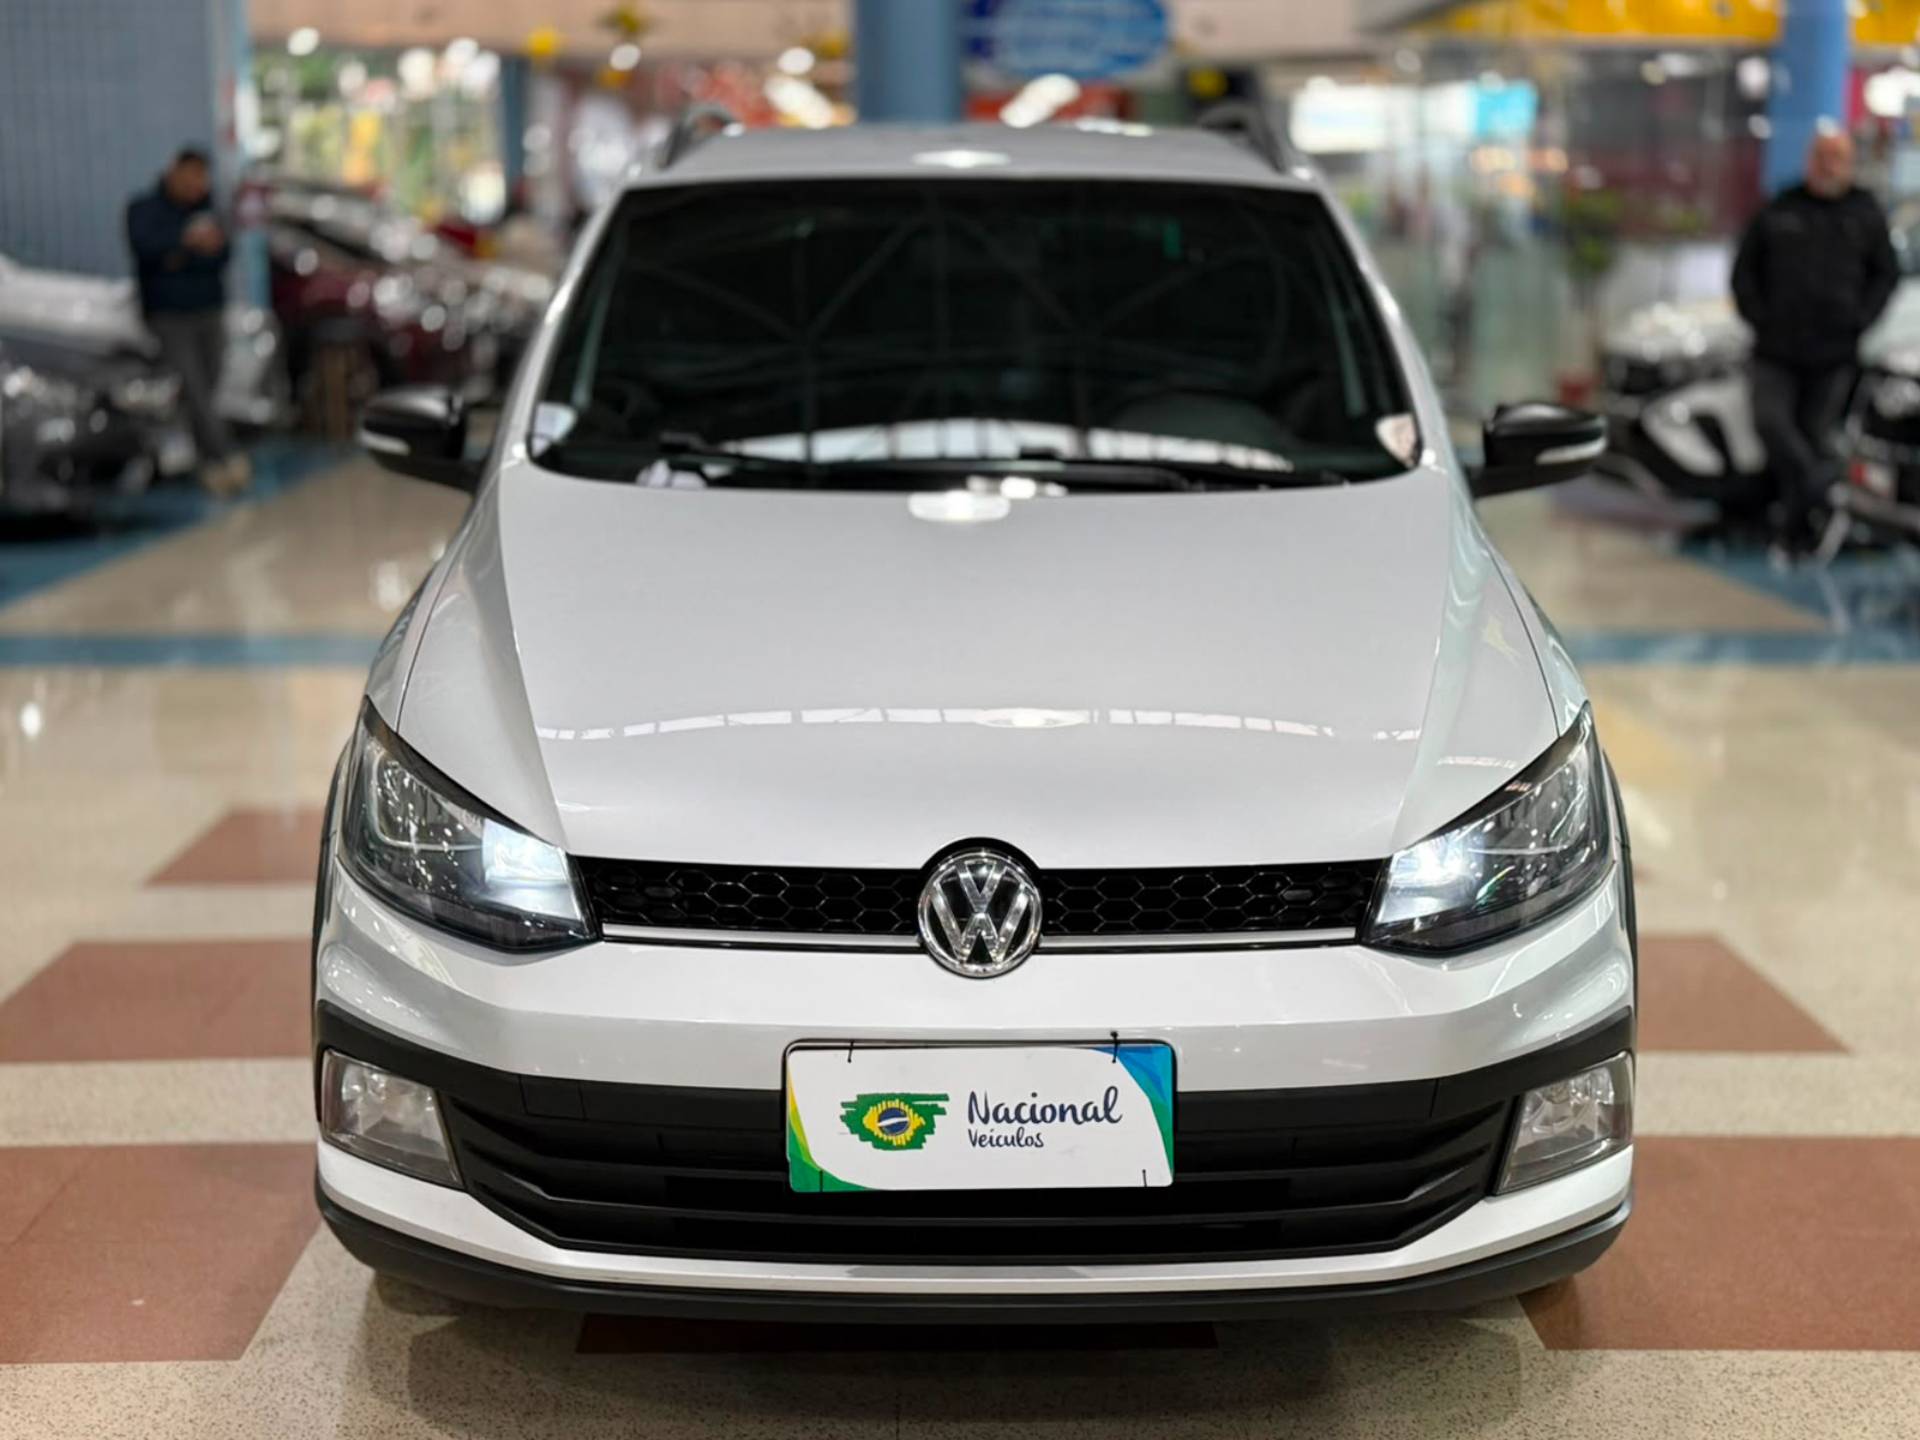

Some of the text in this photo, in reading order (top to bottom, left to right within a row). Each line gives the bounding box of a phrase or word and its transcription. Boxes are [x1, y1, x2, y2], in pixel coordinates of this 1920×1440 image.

[927, 856, 1033, 965] VW
[967, 1086, 1123, 1125] Nacional
[967, 1126, 1045, 1148] Veículos
